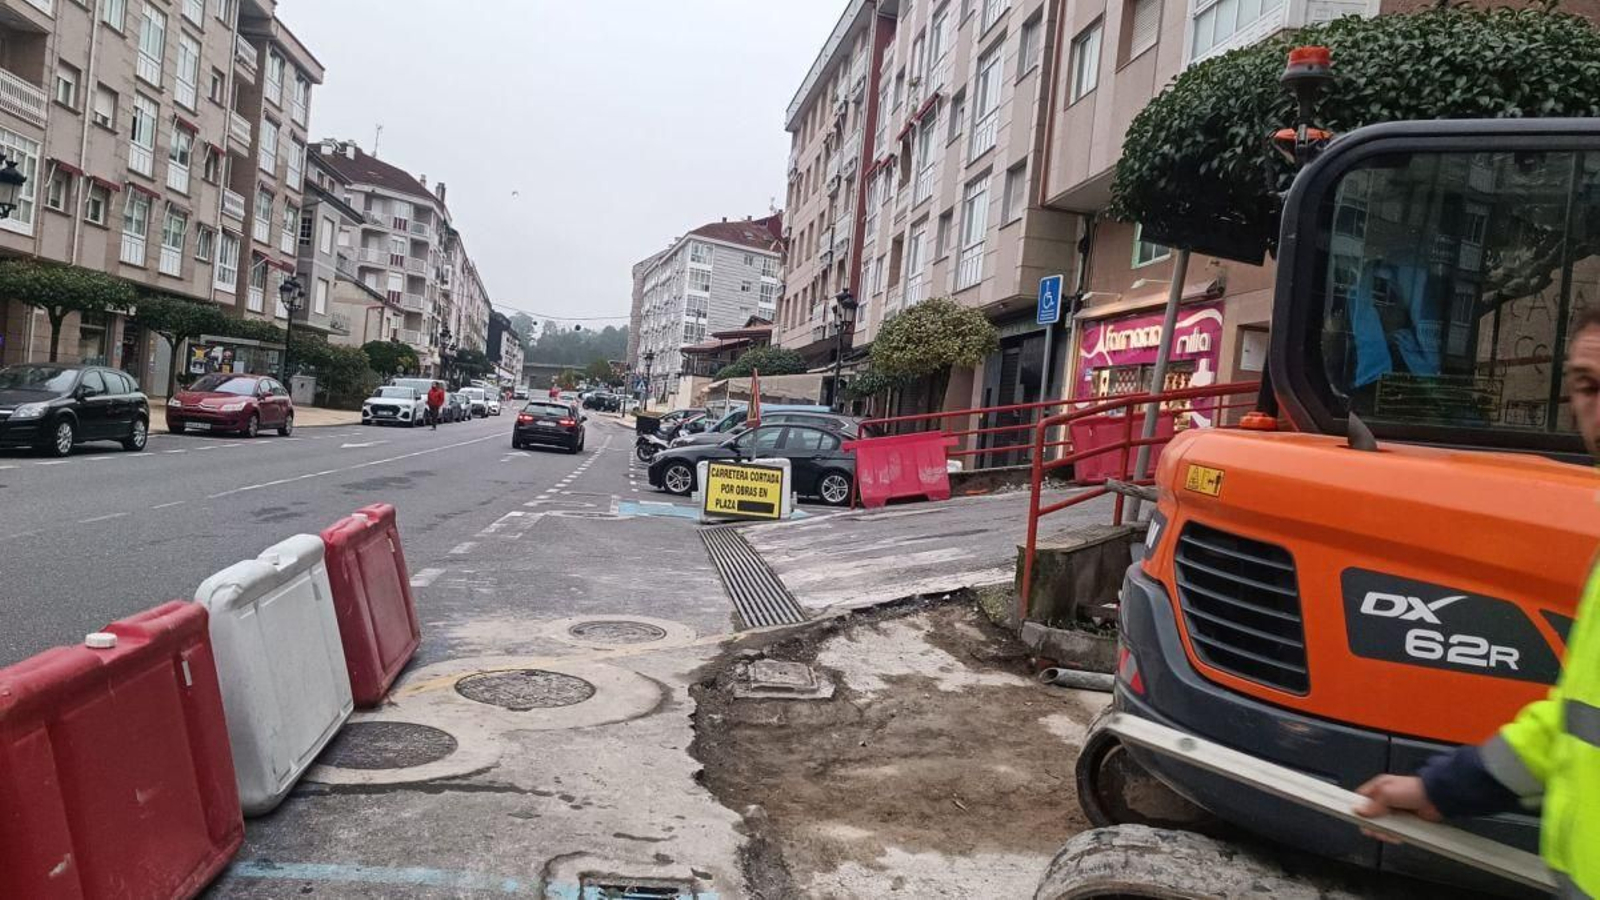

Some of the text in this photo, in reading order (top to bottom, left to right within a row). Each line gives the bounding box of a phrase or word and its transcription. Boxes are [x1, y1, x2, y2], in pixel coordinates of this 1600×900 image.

[711, 467, 779, 484] CARRETERA CORTADA
[721, 483, 768, 498] POR OBRAS EN
[715, 498, 736, 510] PLAZA
[1360, 591, 1469, 625] DX
[1405, 628, 1520, 671] 62R
